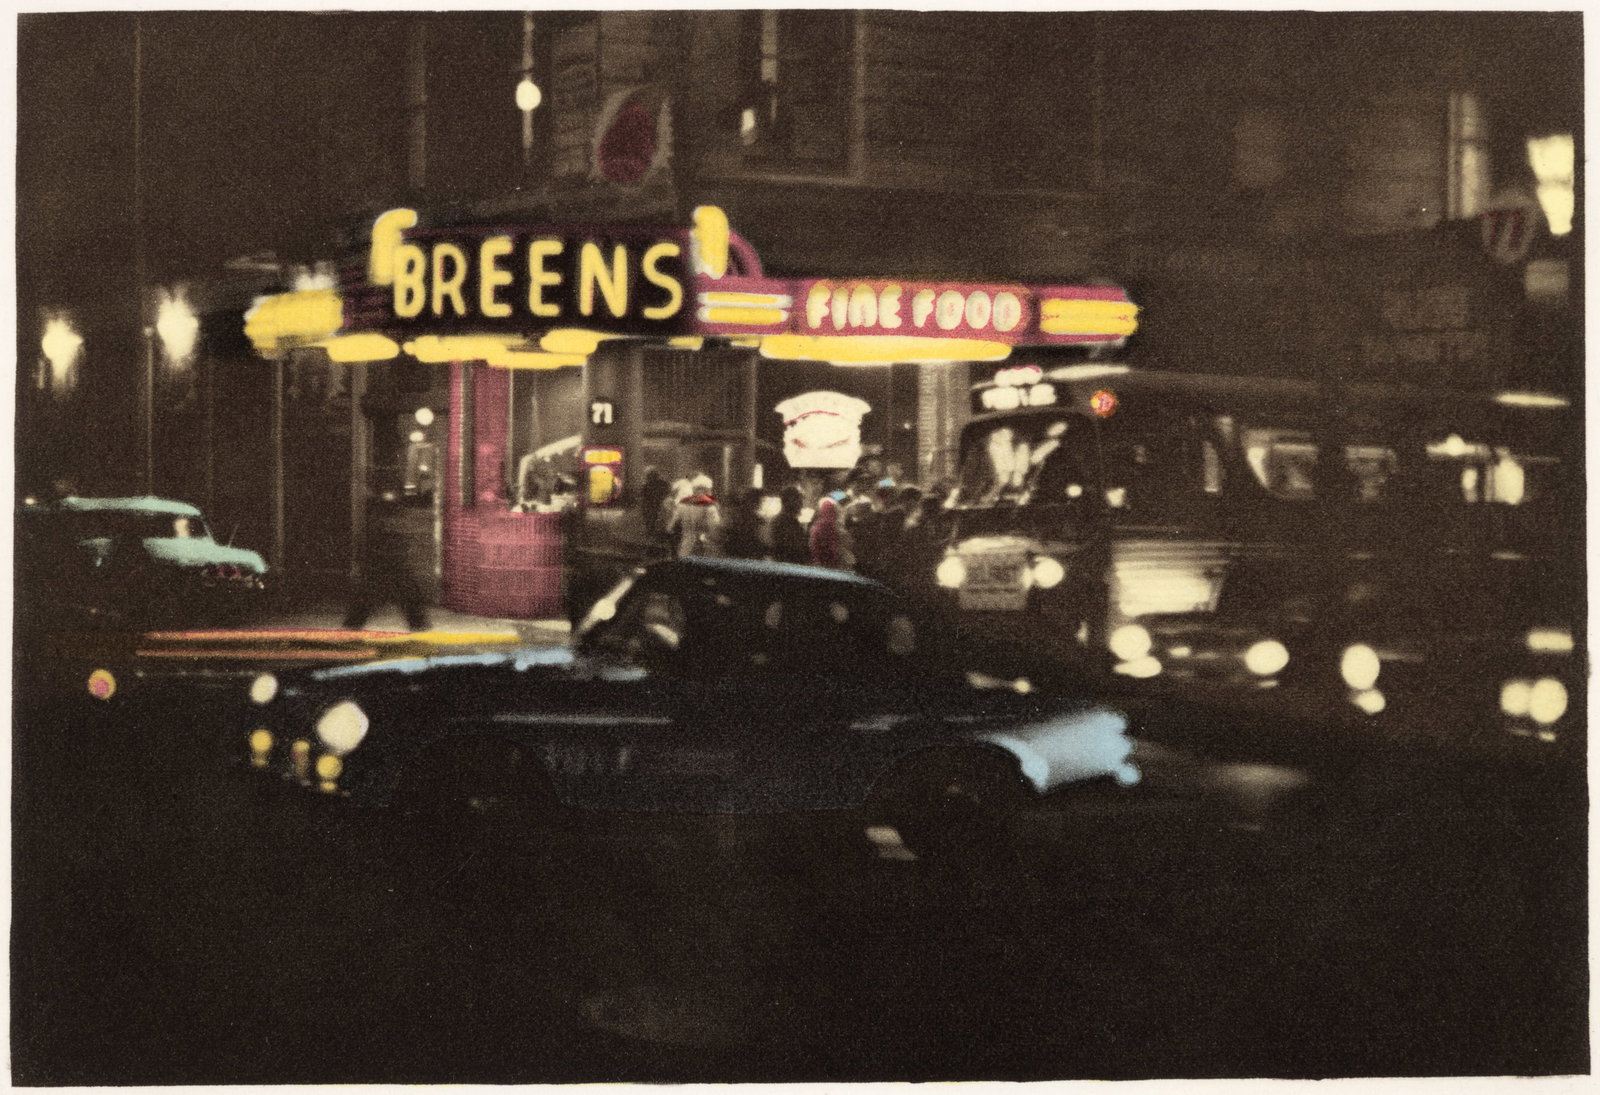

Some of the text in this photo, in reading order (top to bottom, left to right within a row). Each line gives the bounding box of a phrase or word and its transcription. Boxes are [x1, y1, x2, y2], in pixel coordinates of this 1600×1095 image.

[394, 236, 683, 319] BREENS
[806, 280, 1021, 332] FINE FOOD
